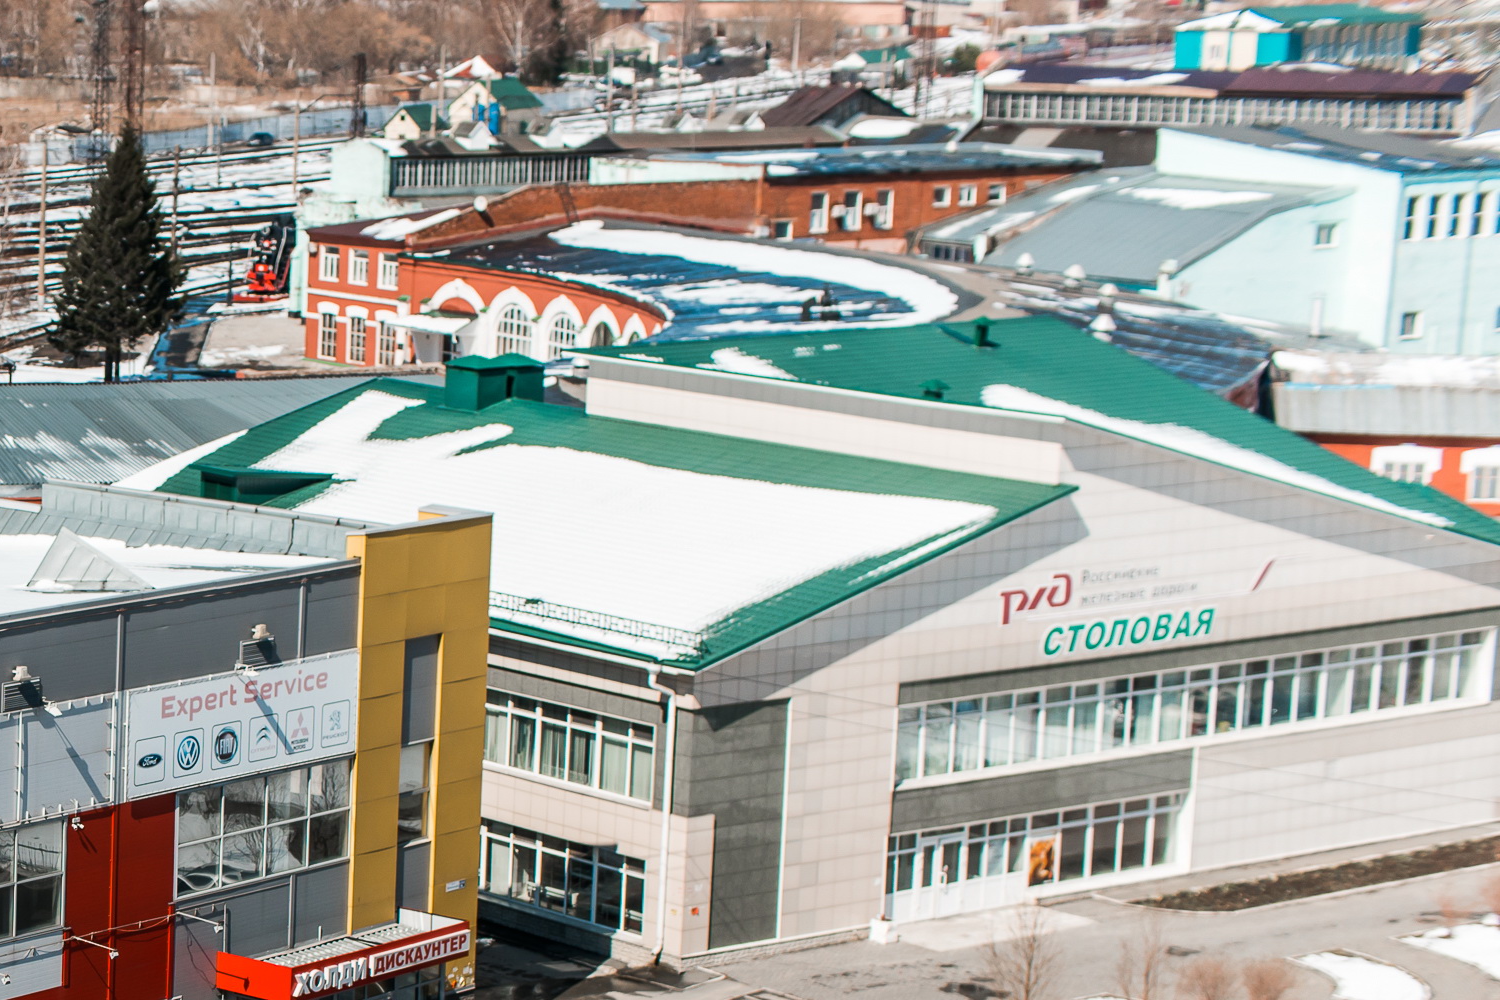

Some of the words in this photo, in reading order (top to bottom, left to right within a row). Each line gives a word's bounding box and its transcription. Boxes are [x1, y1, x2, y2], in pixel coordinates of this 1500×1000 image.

[1043, 608, 1216, 656] СТОЛОВАЯ
[161, 684, 237, 721] Expert
[244, 670, 328, 704] Service
[292, 957, 367, 998] ХОЛДИ
[374, 933, 467, 974] ДИСКАУНТЕР
